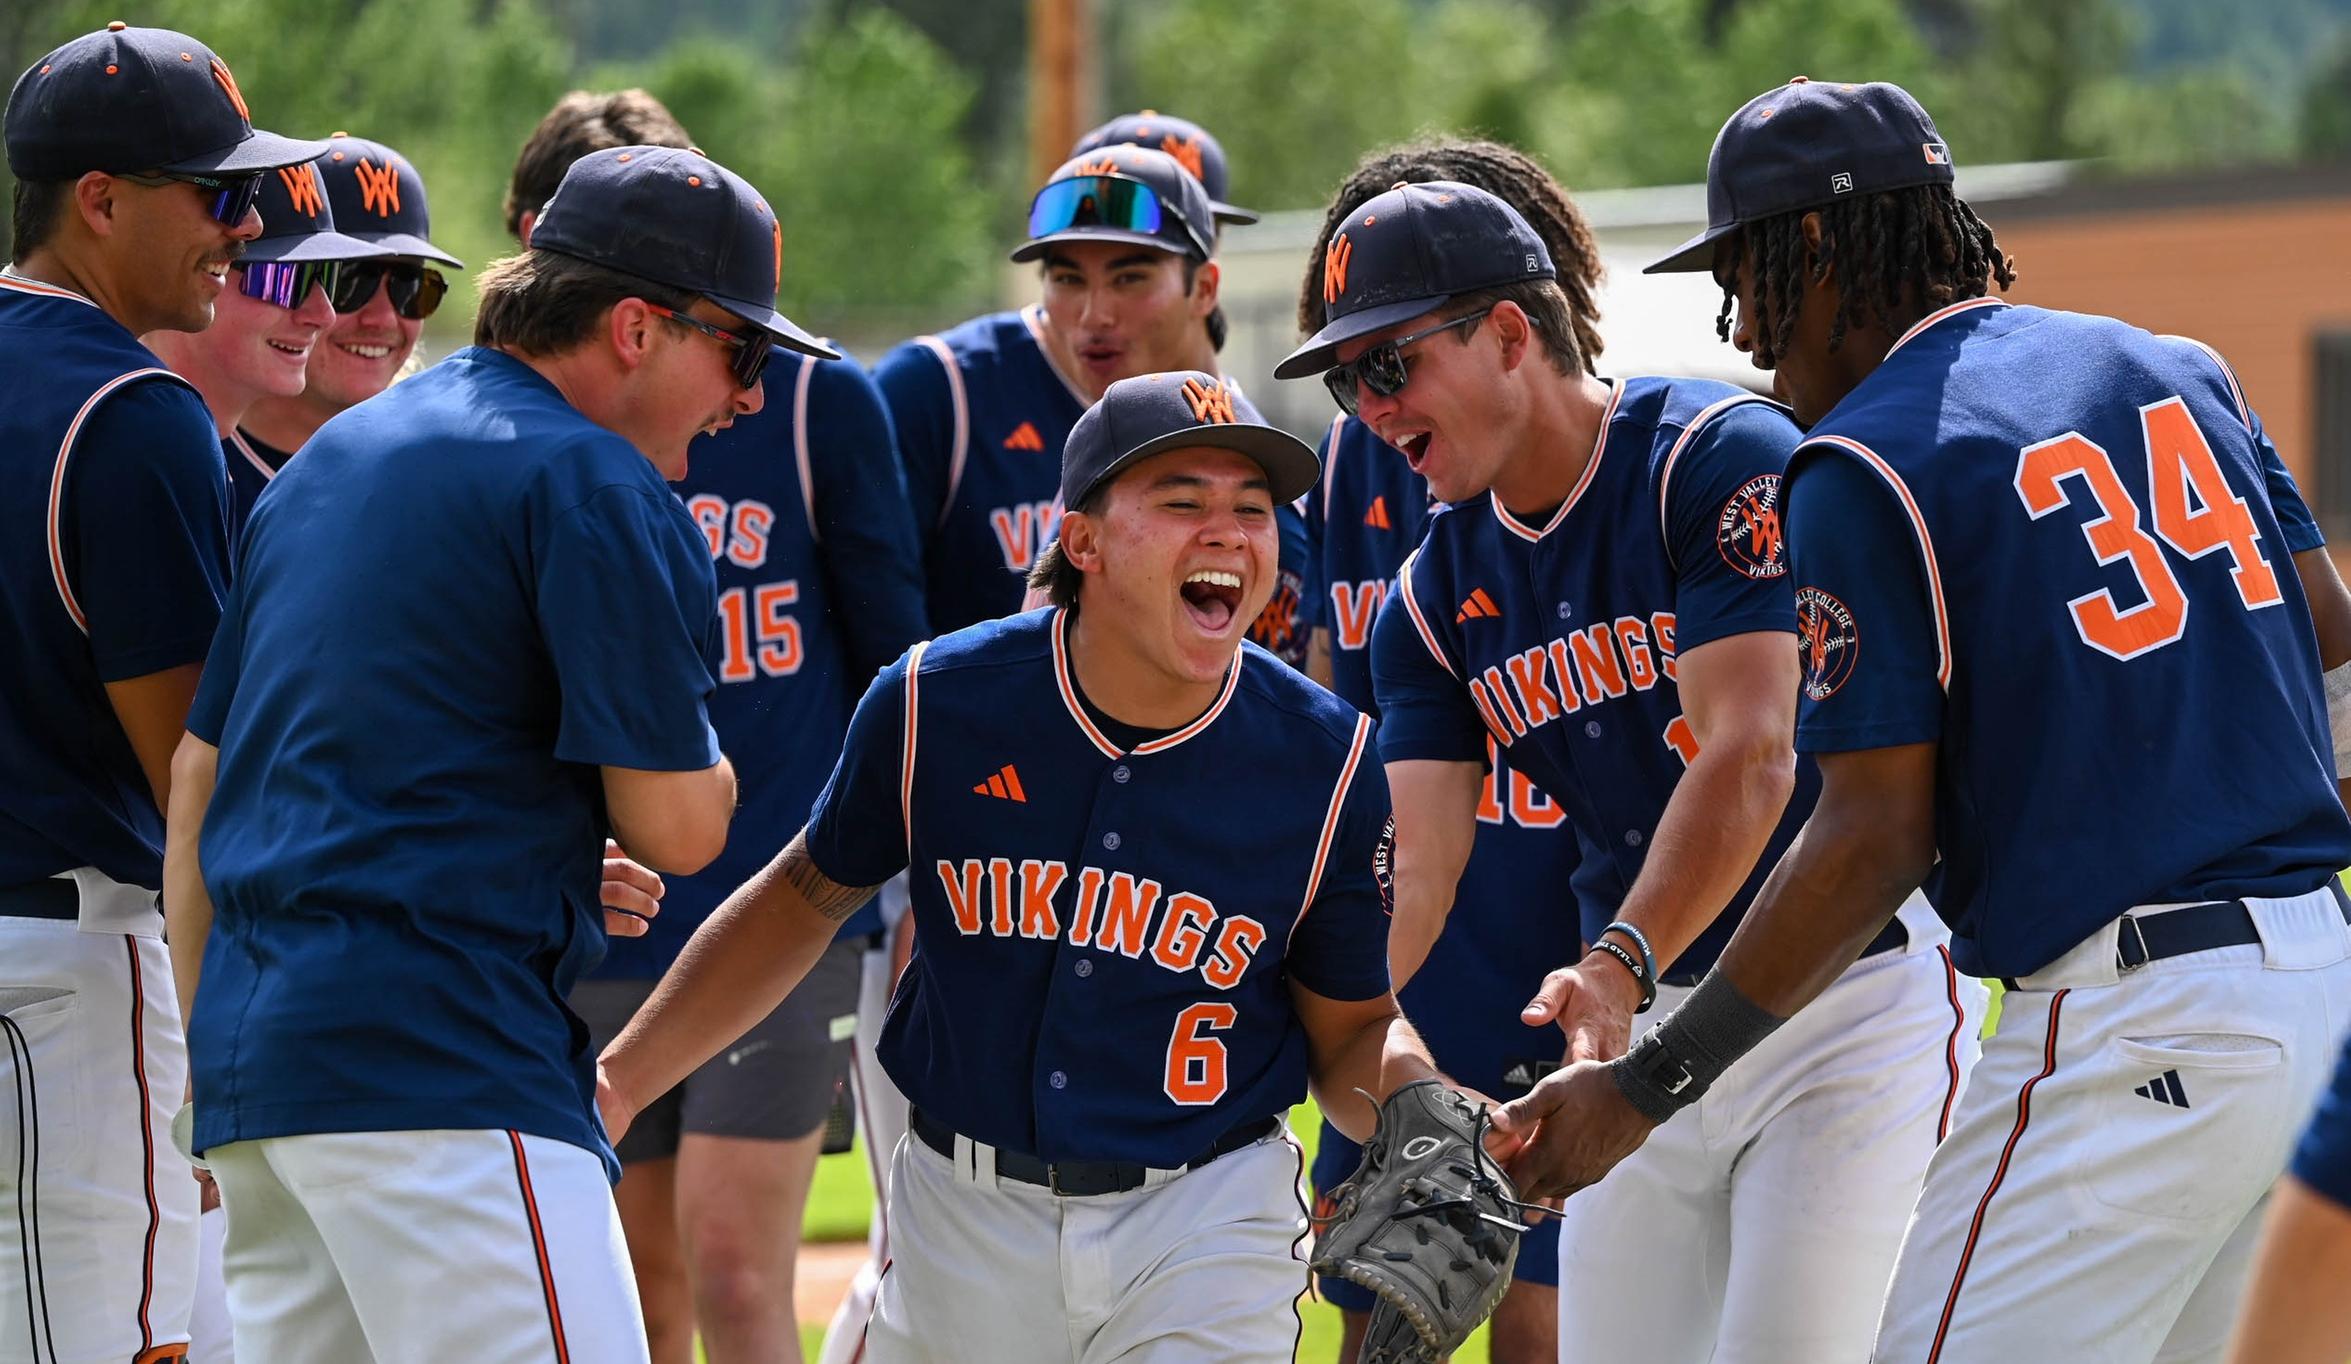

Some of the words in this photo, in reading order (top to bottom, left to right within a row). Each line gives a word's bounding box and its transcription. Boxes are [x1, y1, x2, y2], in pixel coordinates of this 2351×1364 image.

[1721, 500, 1741, 530] WEST
[1740, 477, 1777, 499] VALLEY
[2013, 395, 2285, 662] 34
[717, 579, 804, 684] 15
[1815, 592, 1853, 629] COLLEGE
[1375, 843, 1388, 875] WEST
[936, 858, 1267, 990] VIKINGS
[1163, 1002, 1238, 1106] 6
